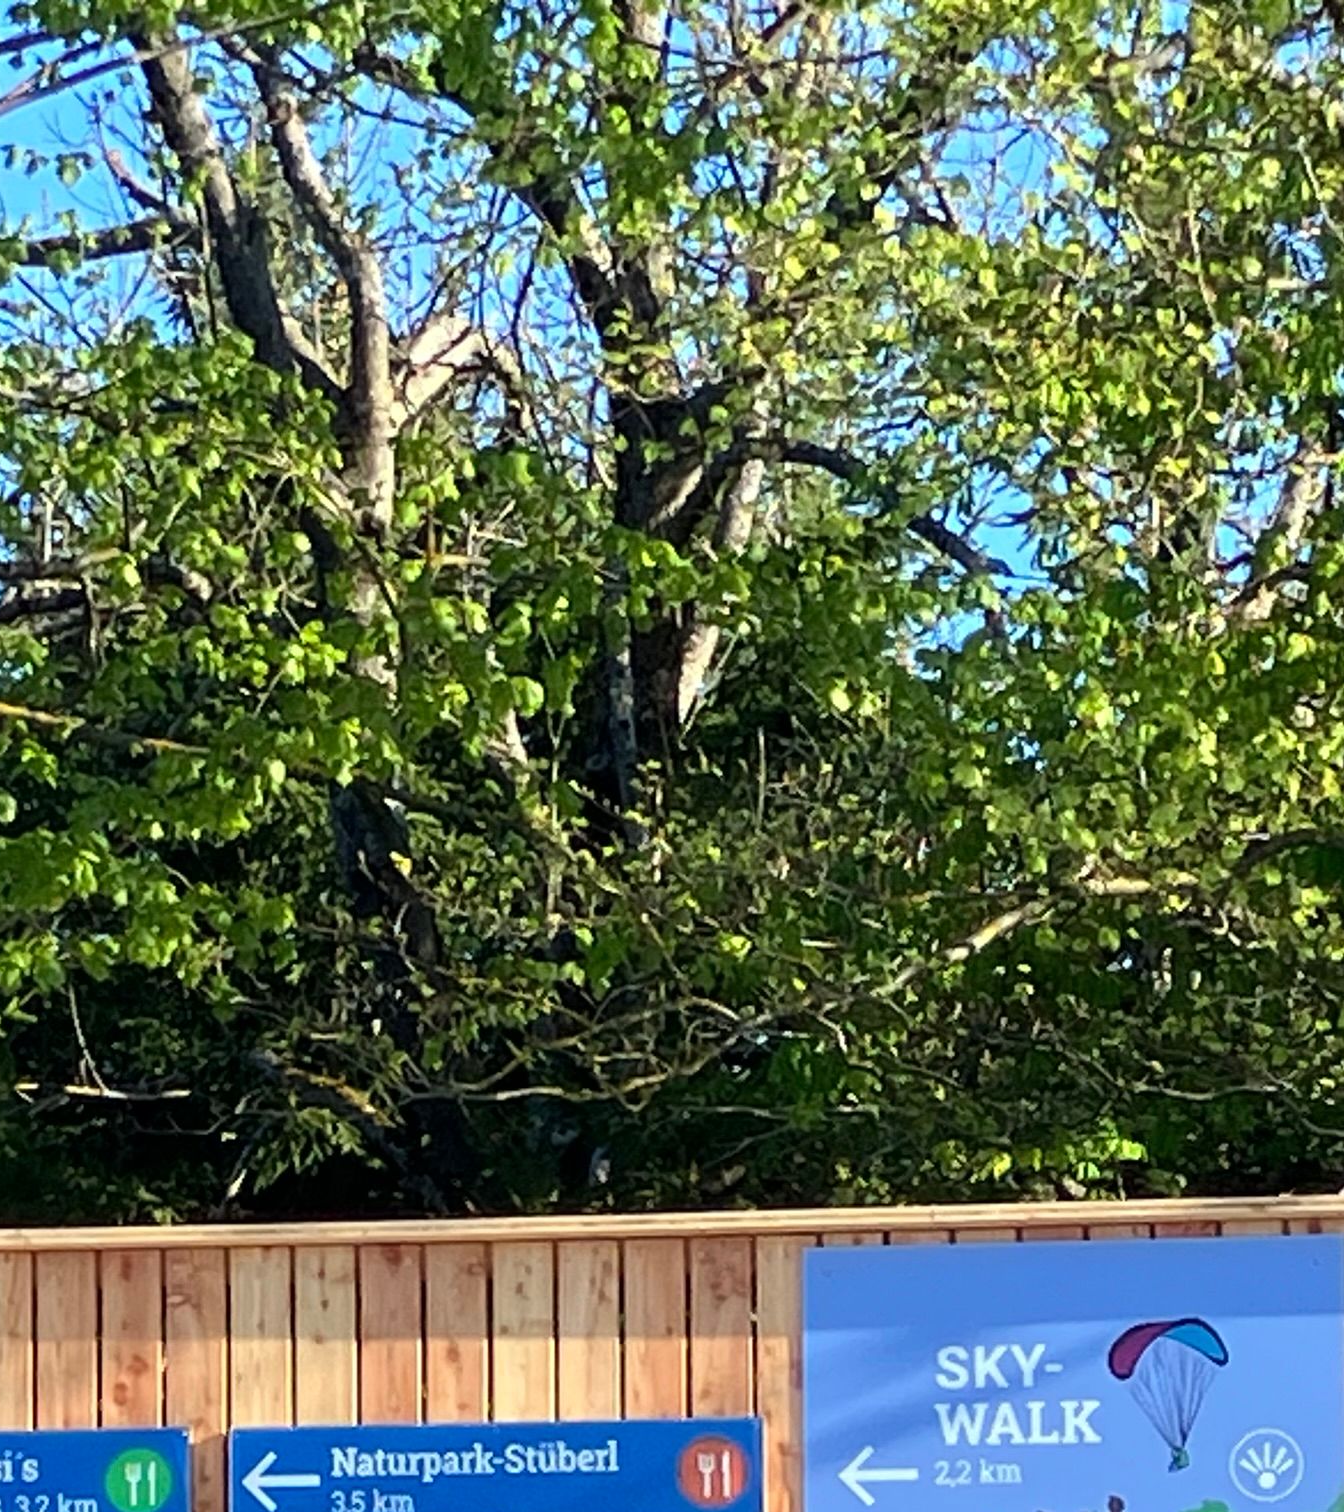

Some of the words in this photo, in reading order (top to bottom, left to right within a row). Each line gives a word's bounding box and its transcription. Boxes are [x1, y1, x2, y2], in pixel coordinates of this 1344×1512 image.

[935, 1343, 1064, 1389] SKY-
[935, 1400, 1102, 1446] WALK
[330, 1439, 619, 1483] Naturpark-Stüberl
[934, 1461, 973, 1488] 2,2
[979, 1458, 1022, 1484] km
